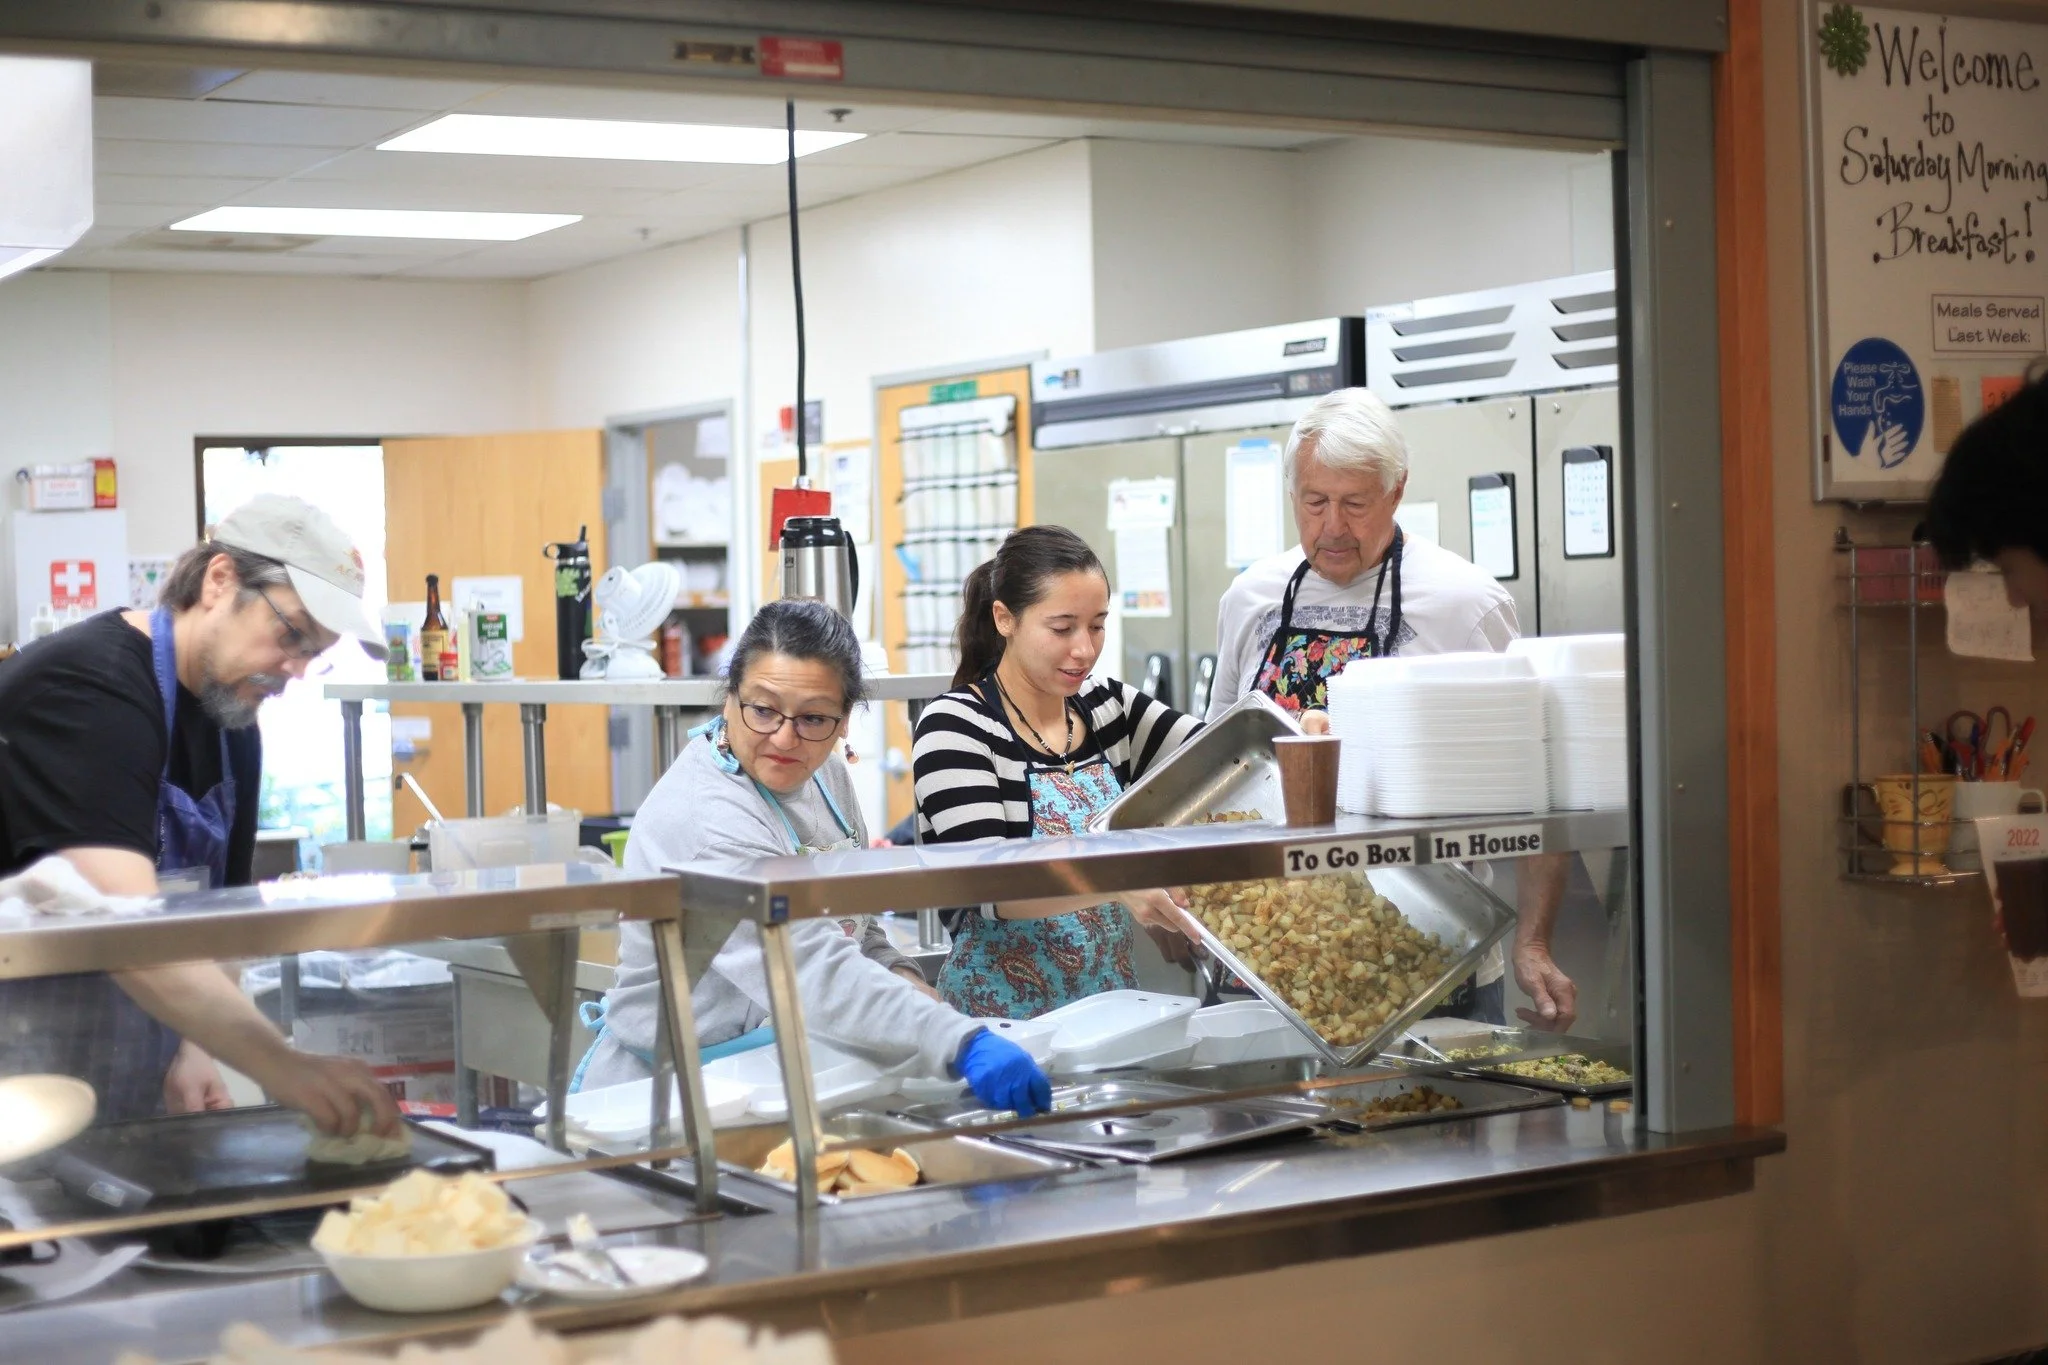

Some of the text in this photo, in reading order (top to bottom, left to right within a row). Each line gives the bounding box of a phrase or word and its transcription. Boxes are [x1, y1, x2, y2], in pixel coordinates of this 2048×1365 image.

[1874, 22, 2040, 94] Welcome
[1923, 94, 1955, 137] to
[1840, 126, 2048, 214] Saturday Morning
[1873, 201, 2036, 264] Breakfast!
[1937, 303, 2040, 318] Meals Served
[1948, 328, 2031, 343] Last Week:
[1844, 362, 1877, 374] Please
[1846, 375, 1876, 388] Wash
[1846, 390, 1871, 402] Your
[1838, 404, 1872, 416] Hands
[1434, 832, 1541, 860] In House
[2007, 828, 2040, 847] 2022
[1287, 843, 1411, 871] To Go Box
